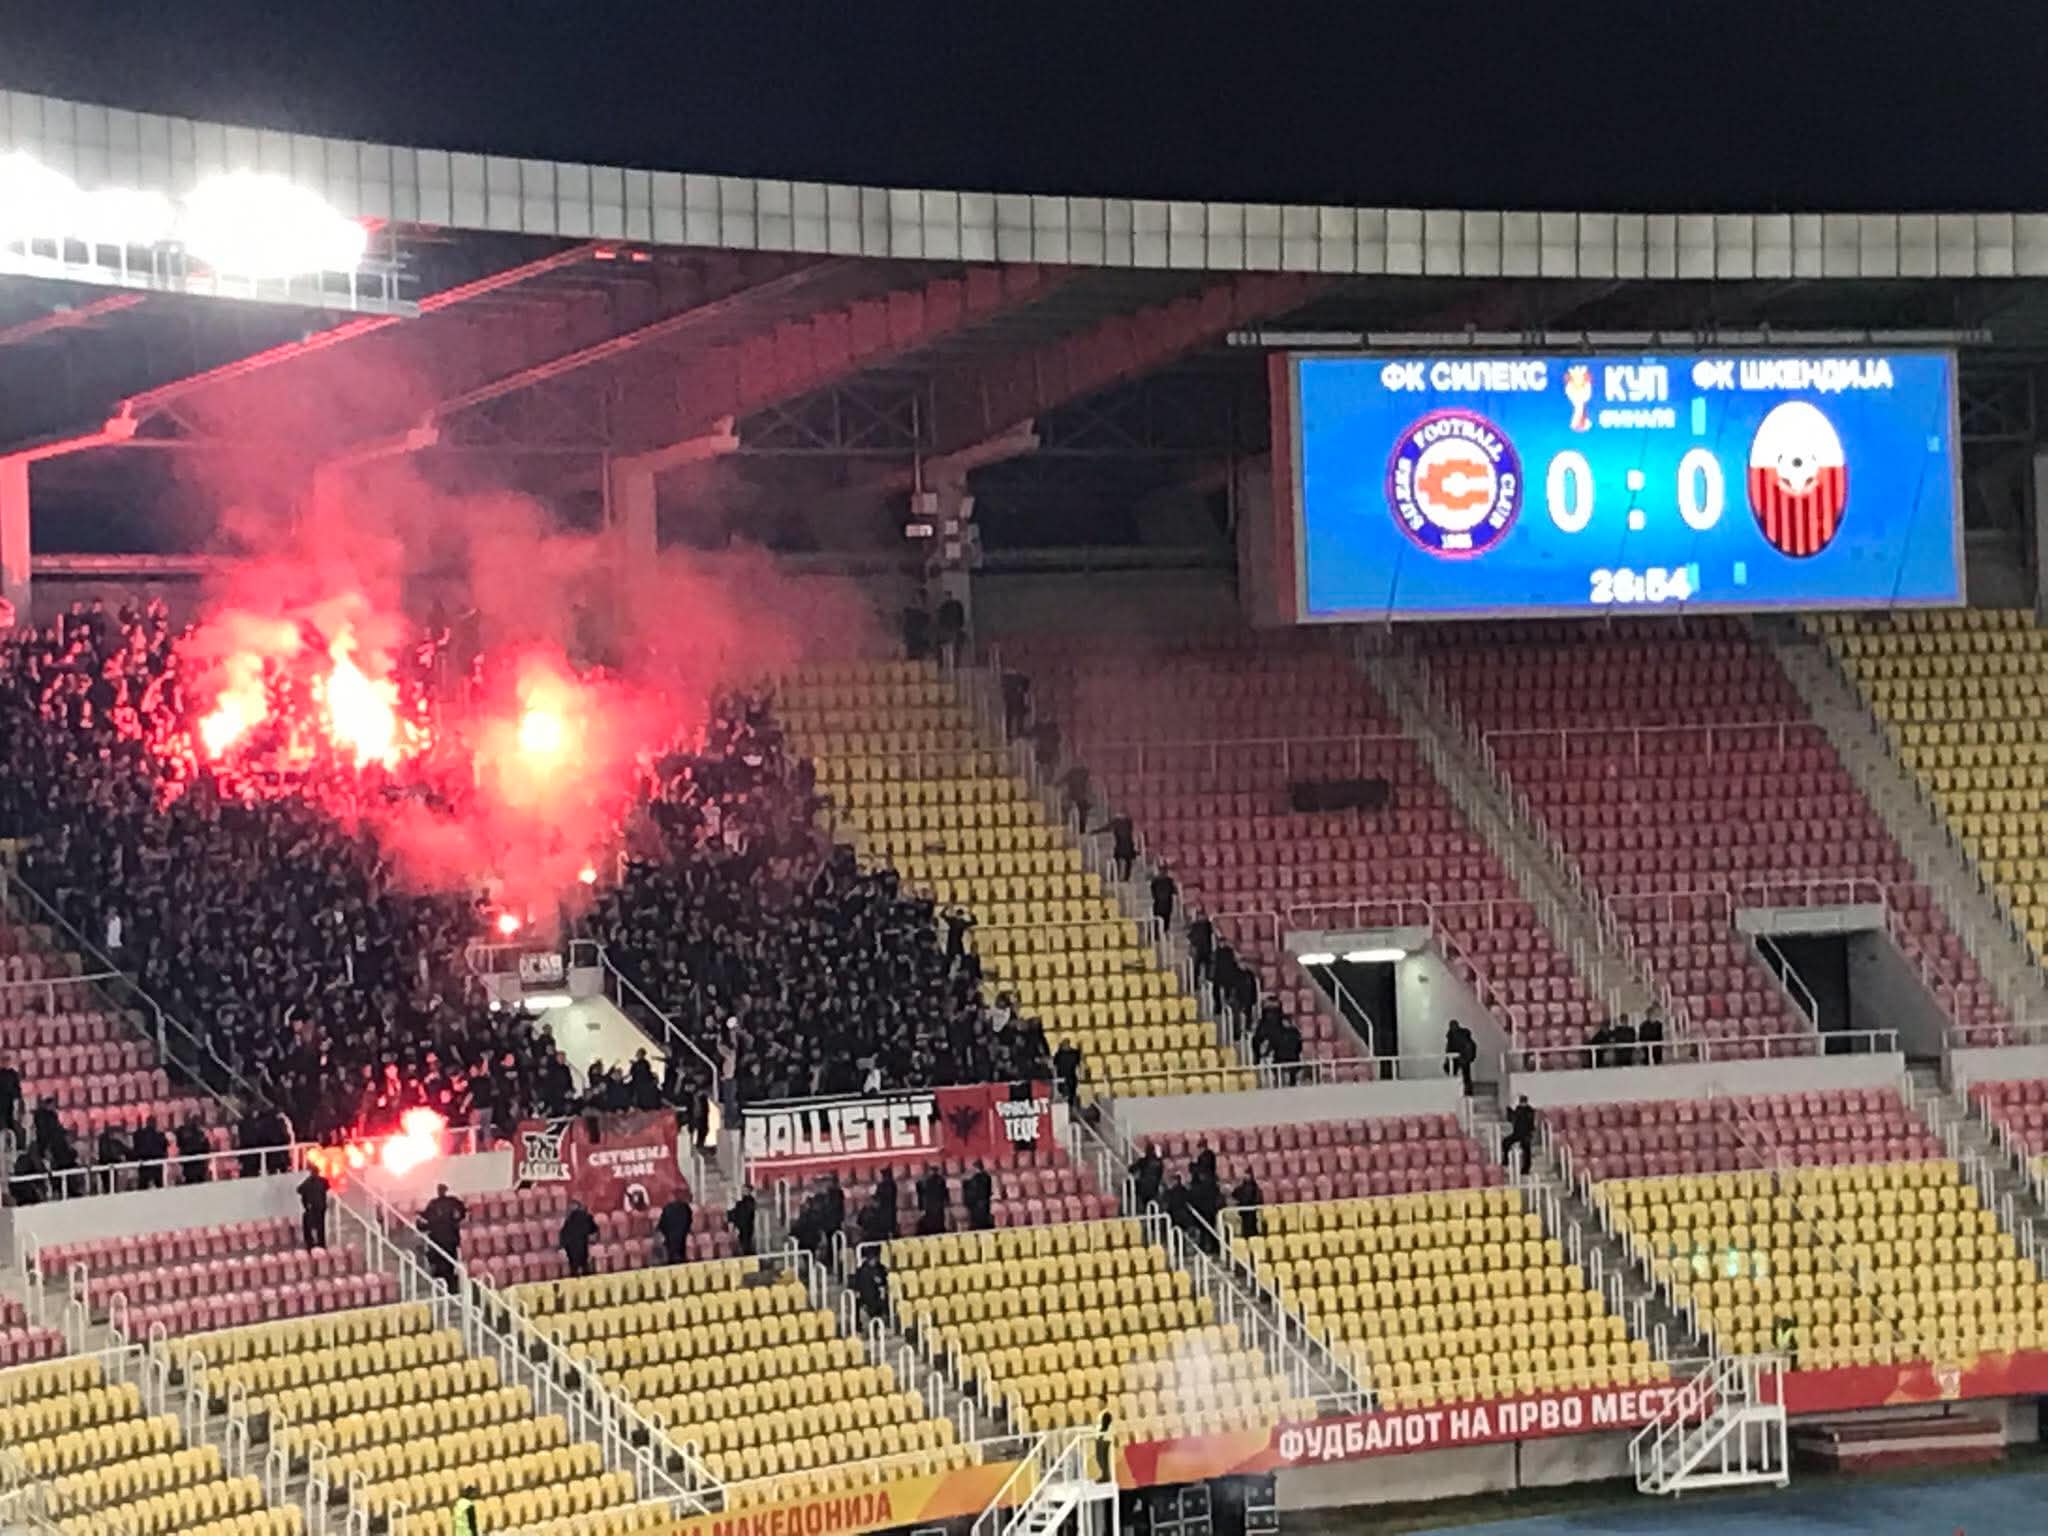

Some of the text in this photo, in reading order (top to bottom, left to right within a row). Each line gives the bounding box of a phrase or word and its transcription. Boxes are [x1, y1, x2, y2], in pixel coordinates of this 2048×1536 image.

[1381, 361, 1547, 391] ФК СИЛЕКС
[1604, 364, 1668, 402] КУП
[1692, 358, 1893, 394] ФК ШКЕНДИЈА
[1413, 418, 1503, 462] FOOTBALL
[1488, 473, 1515, 530] CLUB
[1547, 449, 1593, 532] 0
[1677, 447, 1724, 530] 0
[744, 1097, 934, 1158] BALLISTËT
[1279, 1386, 1698, 1461] ФУДБАЛОТ НА ПРВО МЕСТО
[712, 1490, 892, 1536] МАКЕДОНИЈА
